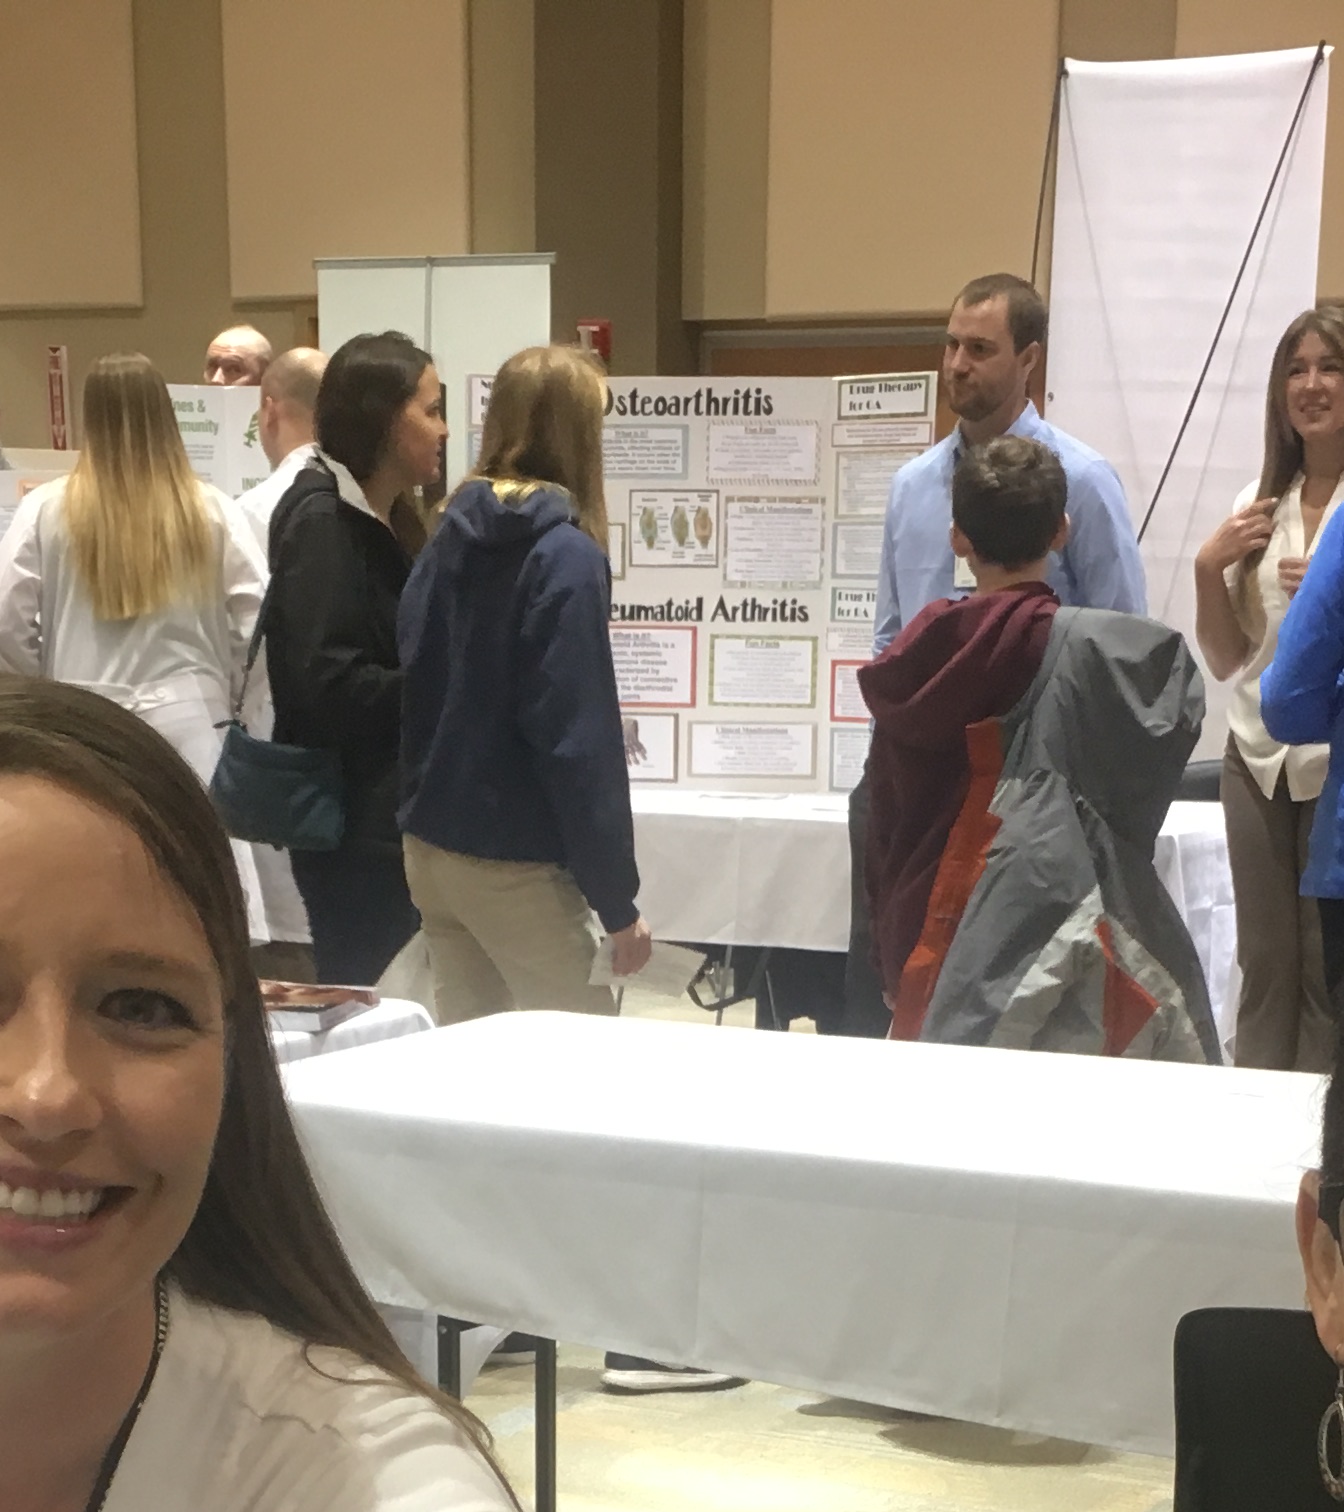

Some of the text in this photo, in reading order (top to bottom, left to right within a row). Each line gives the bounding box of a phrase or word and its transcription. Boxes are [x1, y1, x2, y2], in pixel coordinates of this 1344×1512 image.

[197, 399, 206, 413] &
[608, 595, 809, 623] eumatoid Arthritis
